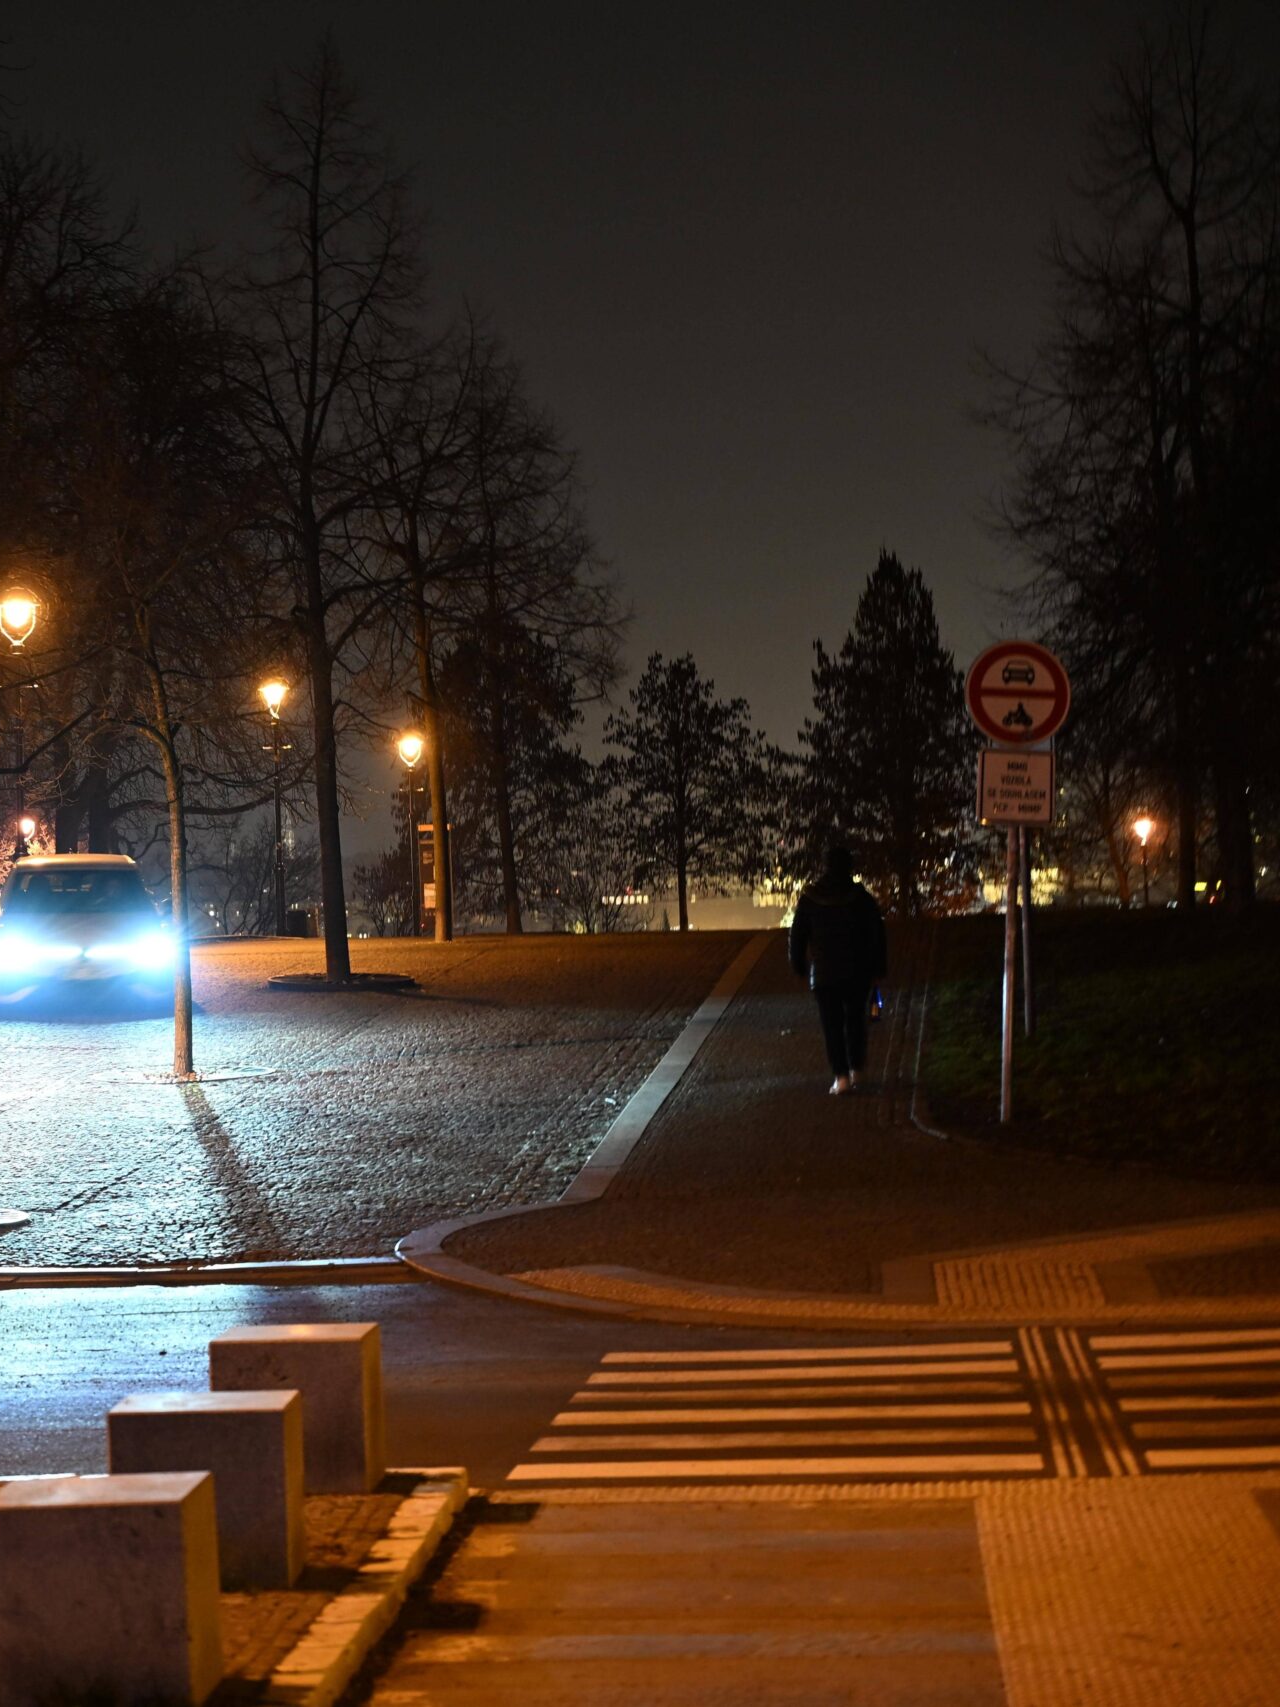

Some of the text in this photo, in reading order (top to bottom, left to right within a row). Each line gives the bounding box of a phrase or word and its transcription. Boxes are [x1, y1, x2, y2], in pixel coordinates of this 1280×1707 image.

[1007, 761, 1028, 771] MIMO
[1000, 775, 1031, 785] VOZIDLA
[999, 788, 1046, 800] SOUHLASEM
